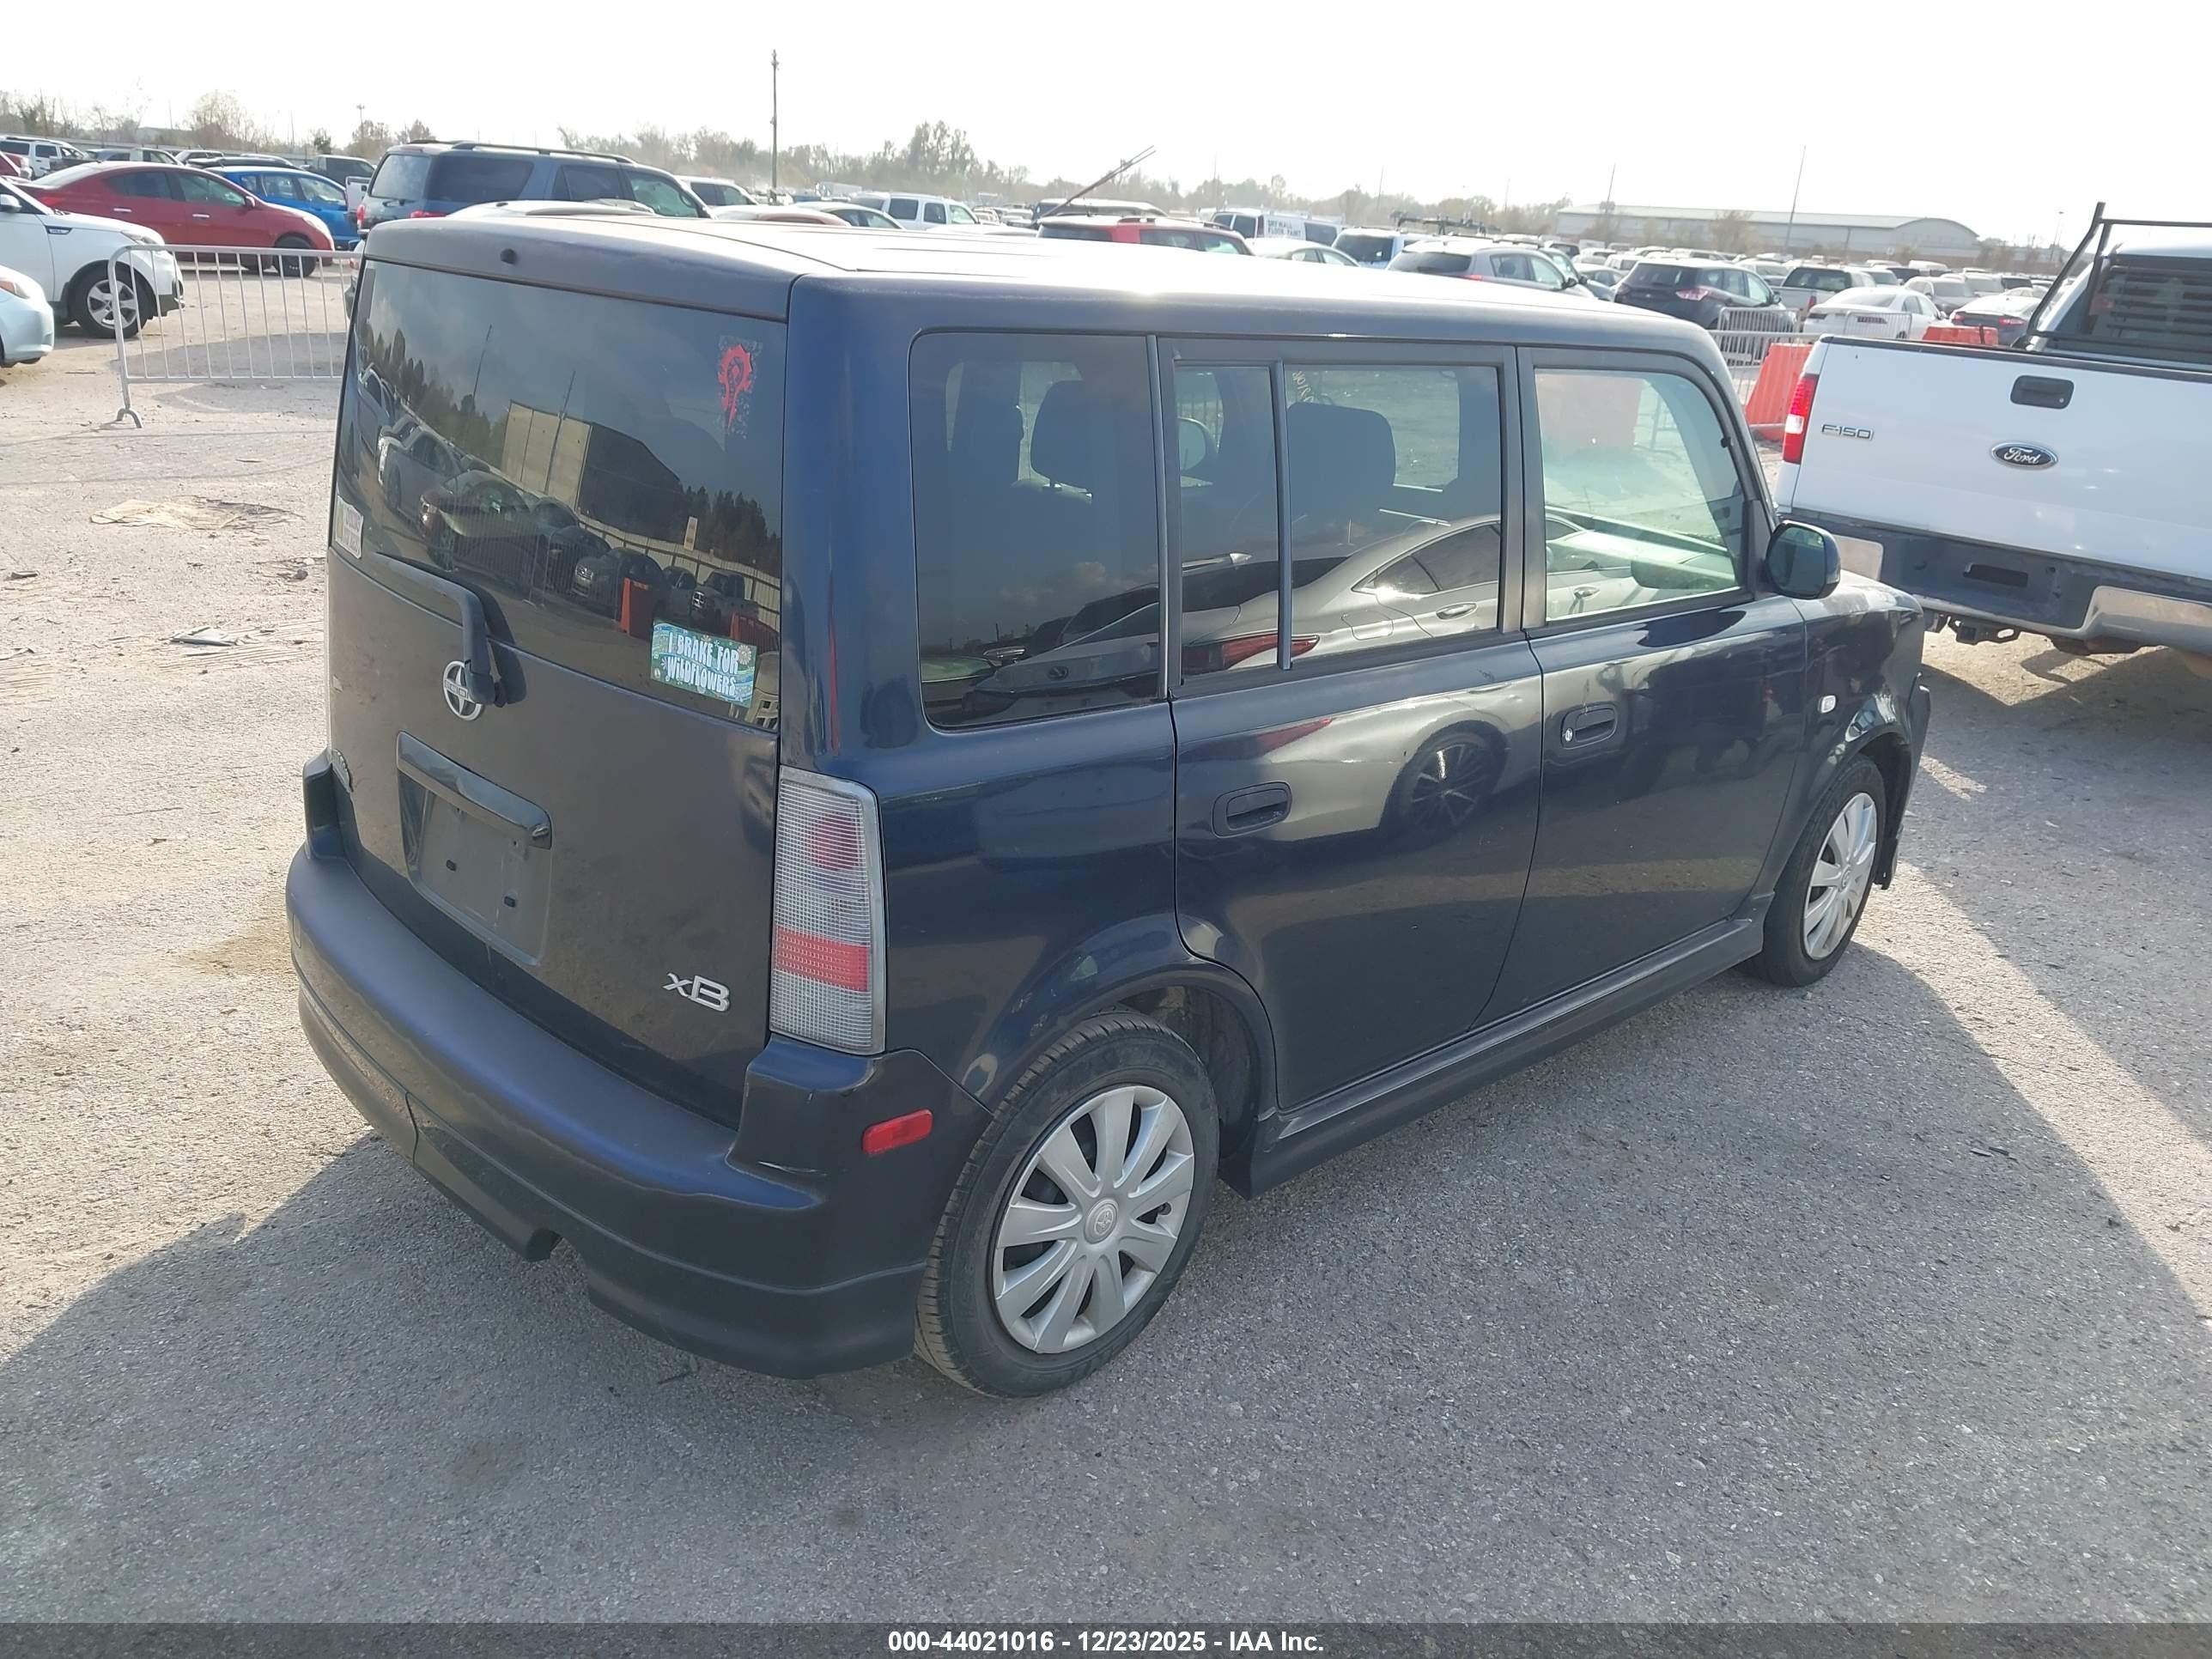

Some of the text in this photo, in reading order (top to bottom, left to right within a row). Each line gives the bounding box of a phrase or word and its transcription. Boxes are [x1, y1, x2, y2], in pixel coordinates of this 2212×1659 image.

[2003, 447, 2041, 464] Ford
[668, 631, 738, 675] I BRAKE FOR
[662, 972, 731, 1012] xB
